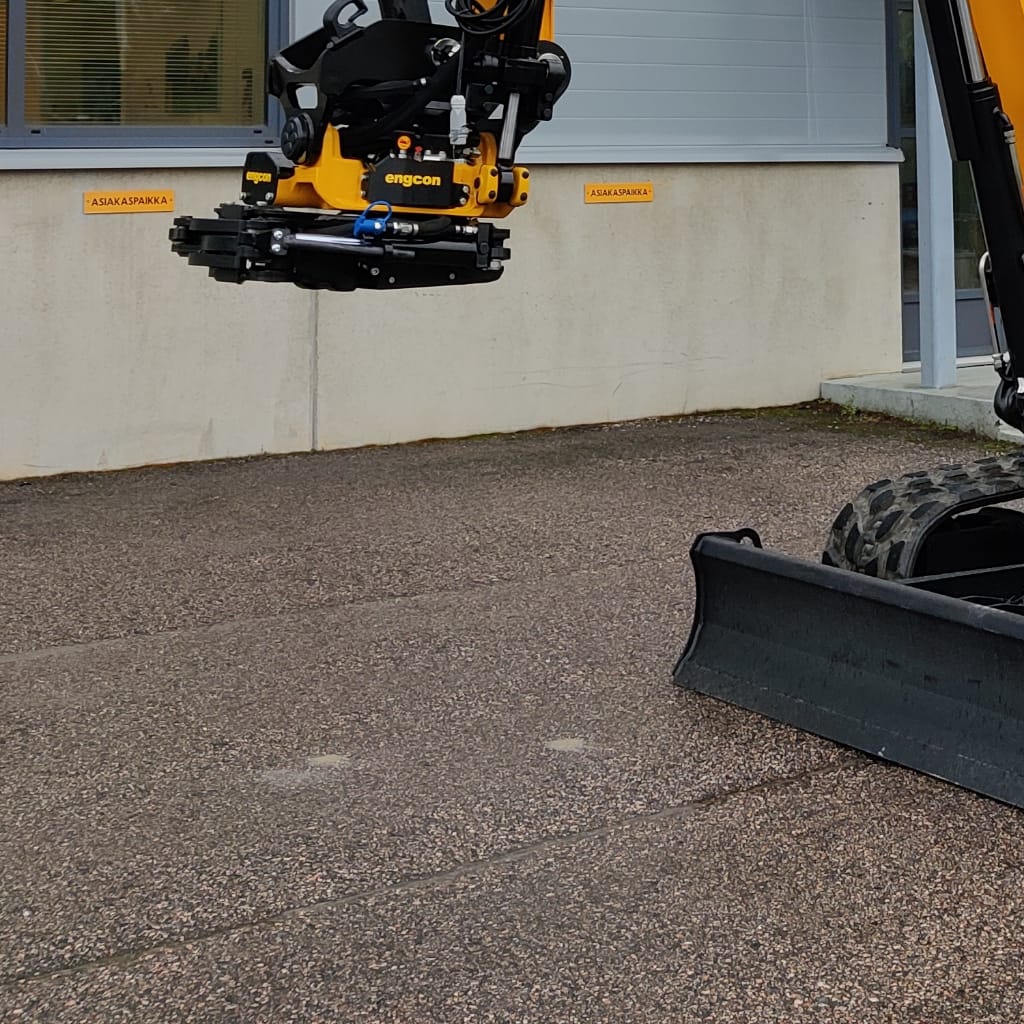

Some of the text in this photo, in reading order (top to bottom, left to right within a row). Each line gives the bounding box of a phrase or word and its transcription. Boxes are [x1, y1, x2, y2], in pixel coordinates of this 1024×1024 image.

[246, 171, 272, 184] engcon
[385, 173, 441, 187] engcon
[91, 196, 168, 206] ASIAKASPAIKKA
